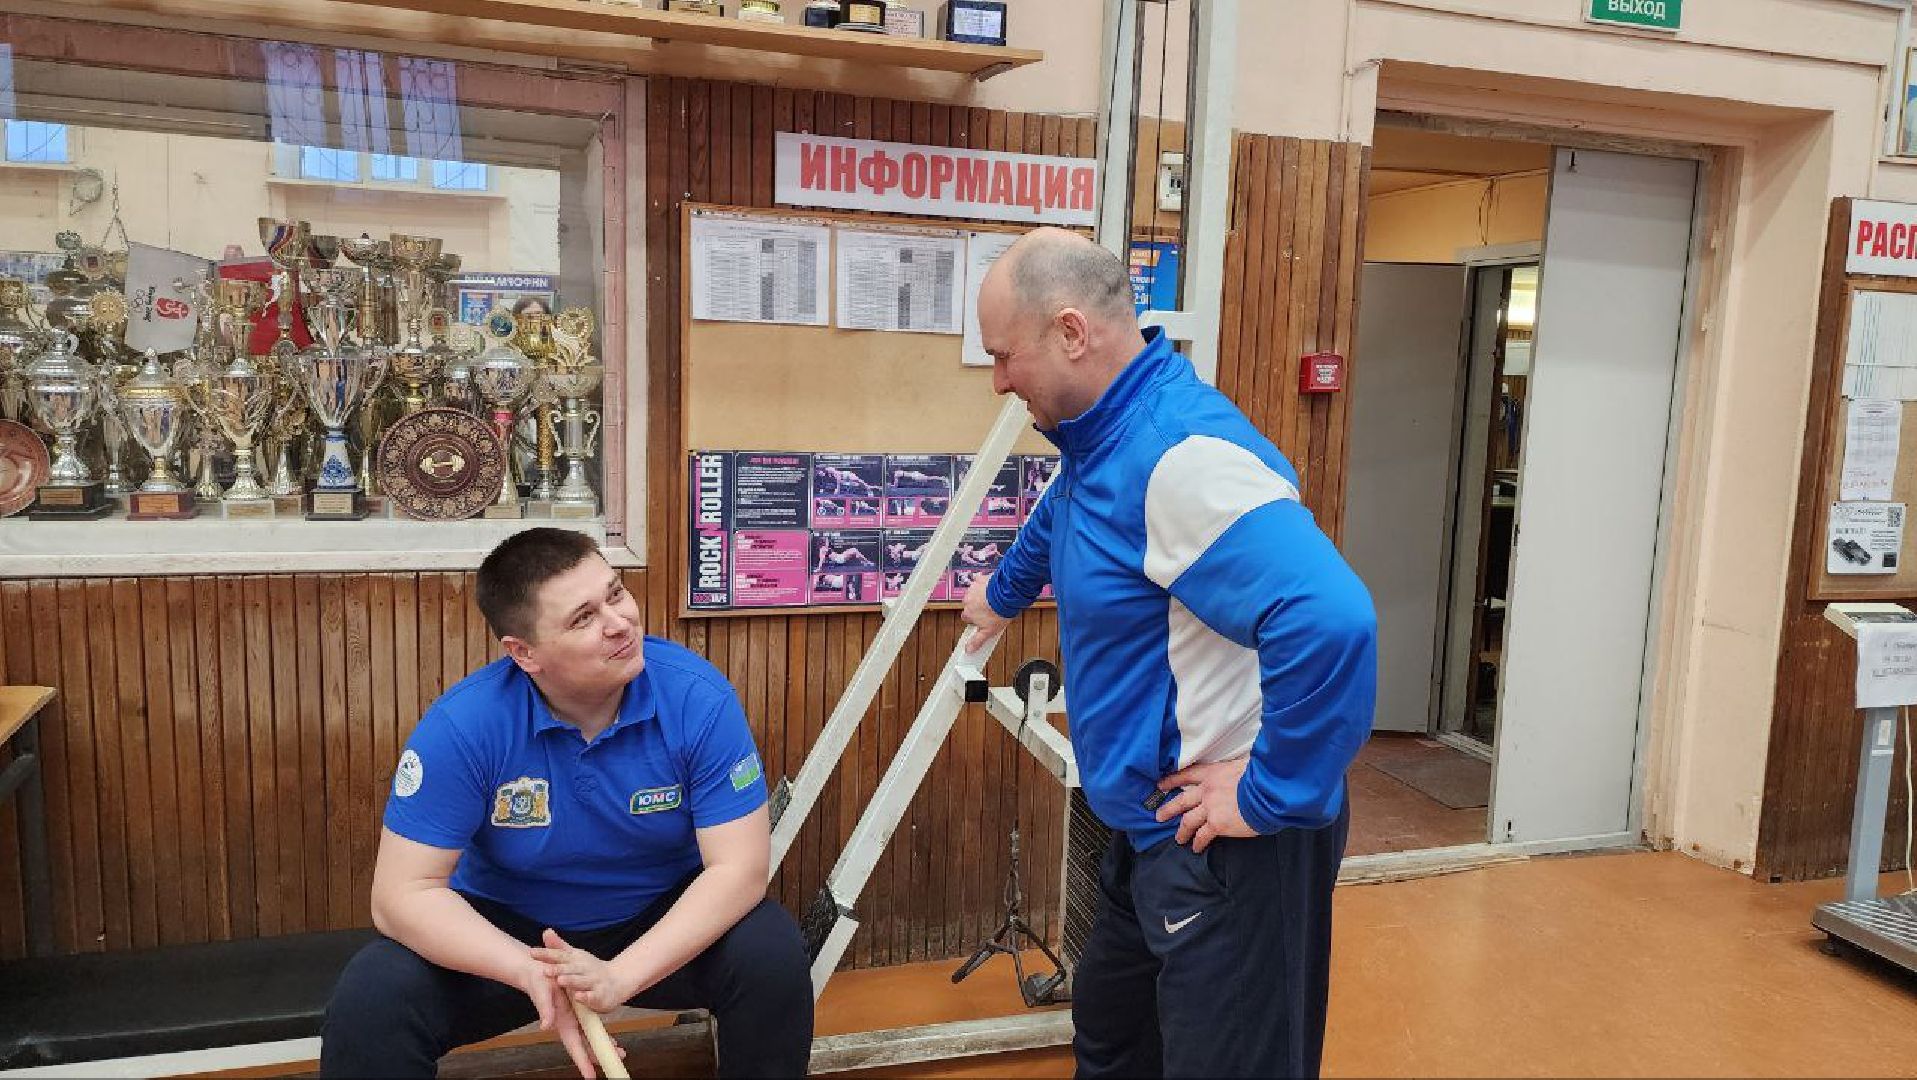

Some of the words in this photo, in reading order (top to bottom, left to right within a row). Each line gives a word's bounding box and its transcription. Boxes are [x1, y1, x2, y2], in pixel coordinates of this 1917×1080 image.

[1607, 0, 1666, 20] ВЫХОД
[800, 142, 1094, 214] ИНФОРМАЦИЯ
[701, 455, 723, 523] ROLLER
[699, 536, 722, 588] ROCK
[638, 791, 676, 806] ЮМС
